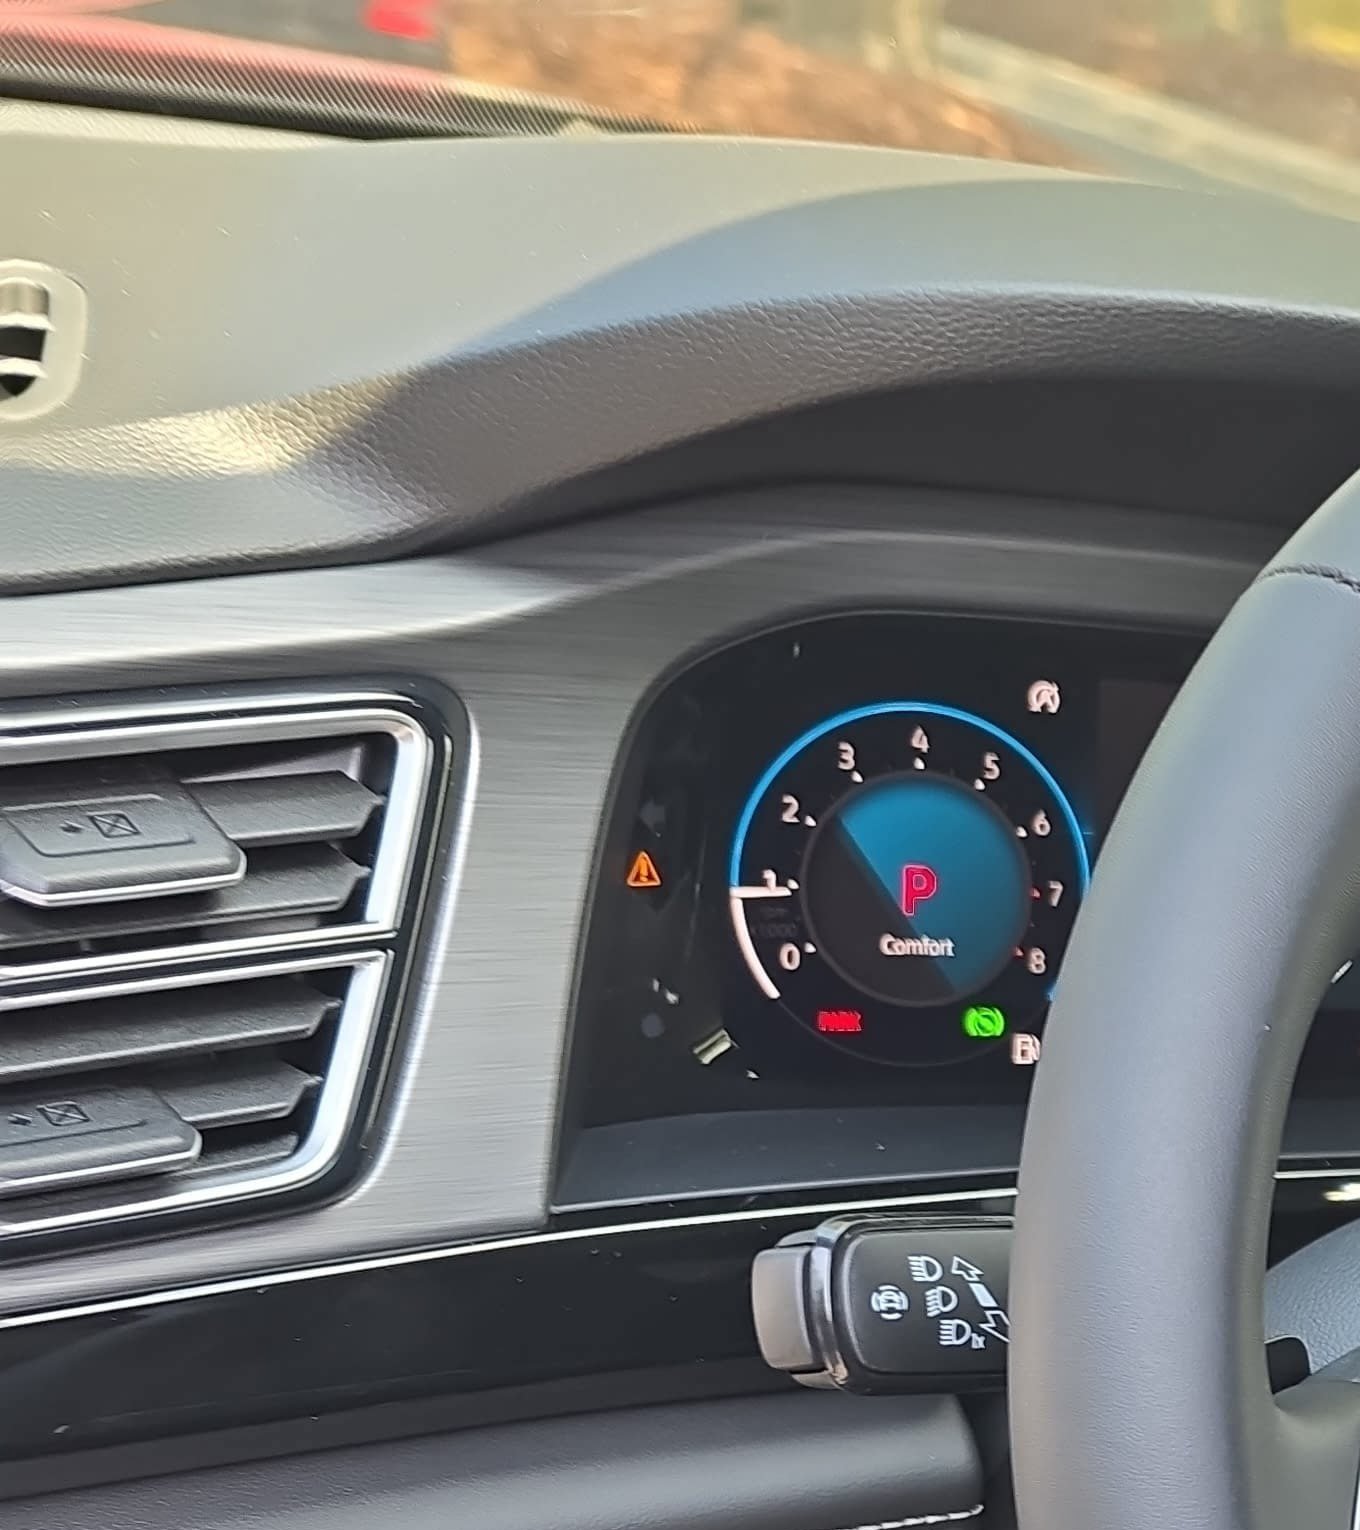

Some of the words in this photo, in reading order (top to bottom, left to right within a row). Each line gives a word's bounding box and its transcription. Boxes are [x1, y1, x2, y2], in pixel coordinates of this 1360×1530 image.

[910, 725, 930, 752] 4
[838, 742, 856, 771] 3
[983, 752, 1001, 780] 5
[781, 794, 801, 823] 2
[1032, 811, 1052, 837] 6
[902, 864, 938, 916] P
[1048, 880, 1064, 908] 7
[779, 943, 801, 971] 0
[879, 933, 955, 958] Comfort
[1028, 947, 1047, 975] 8
